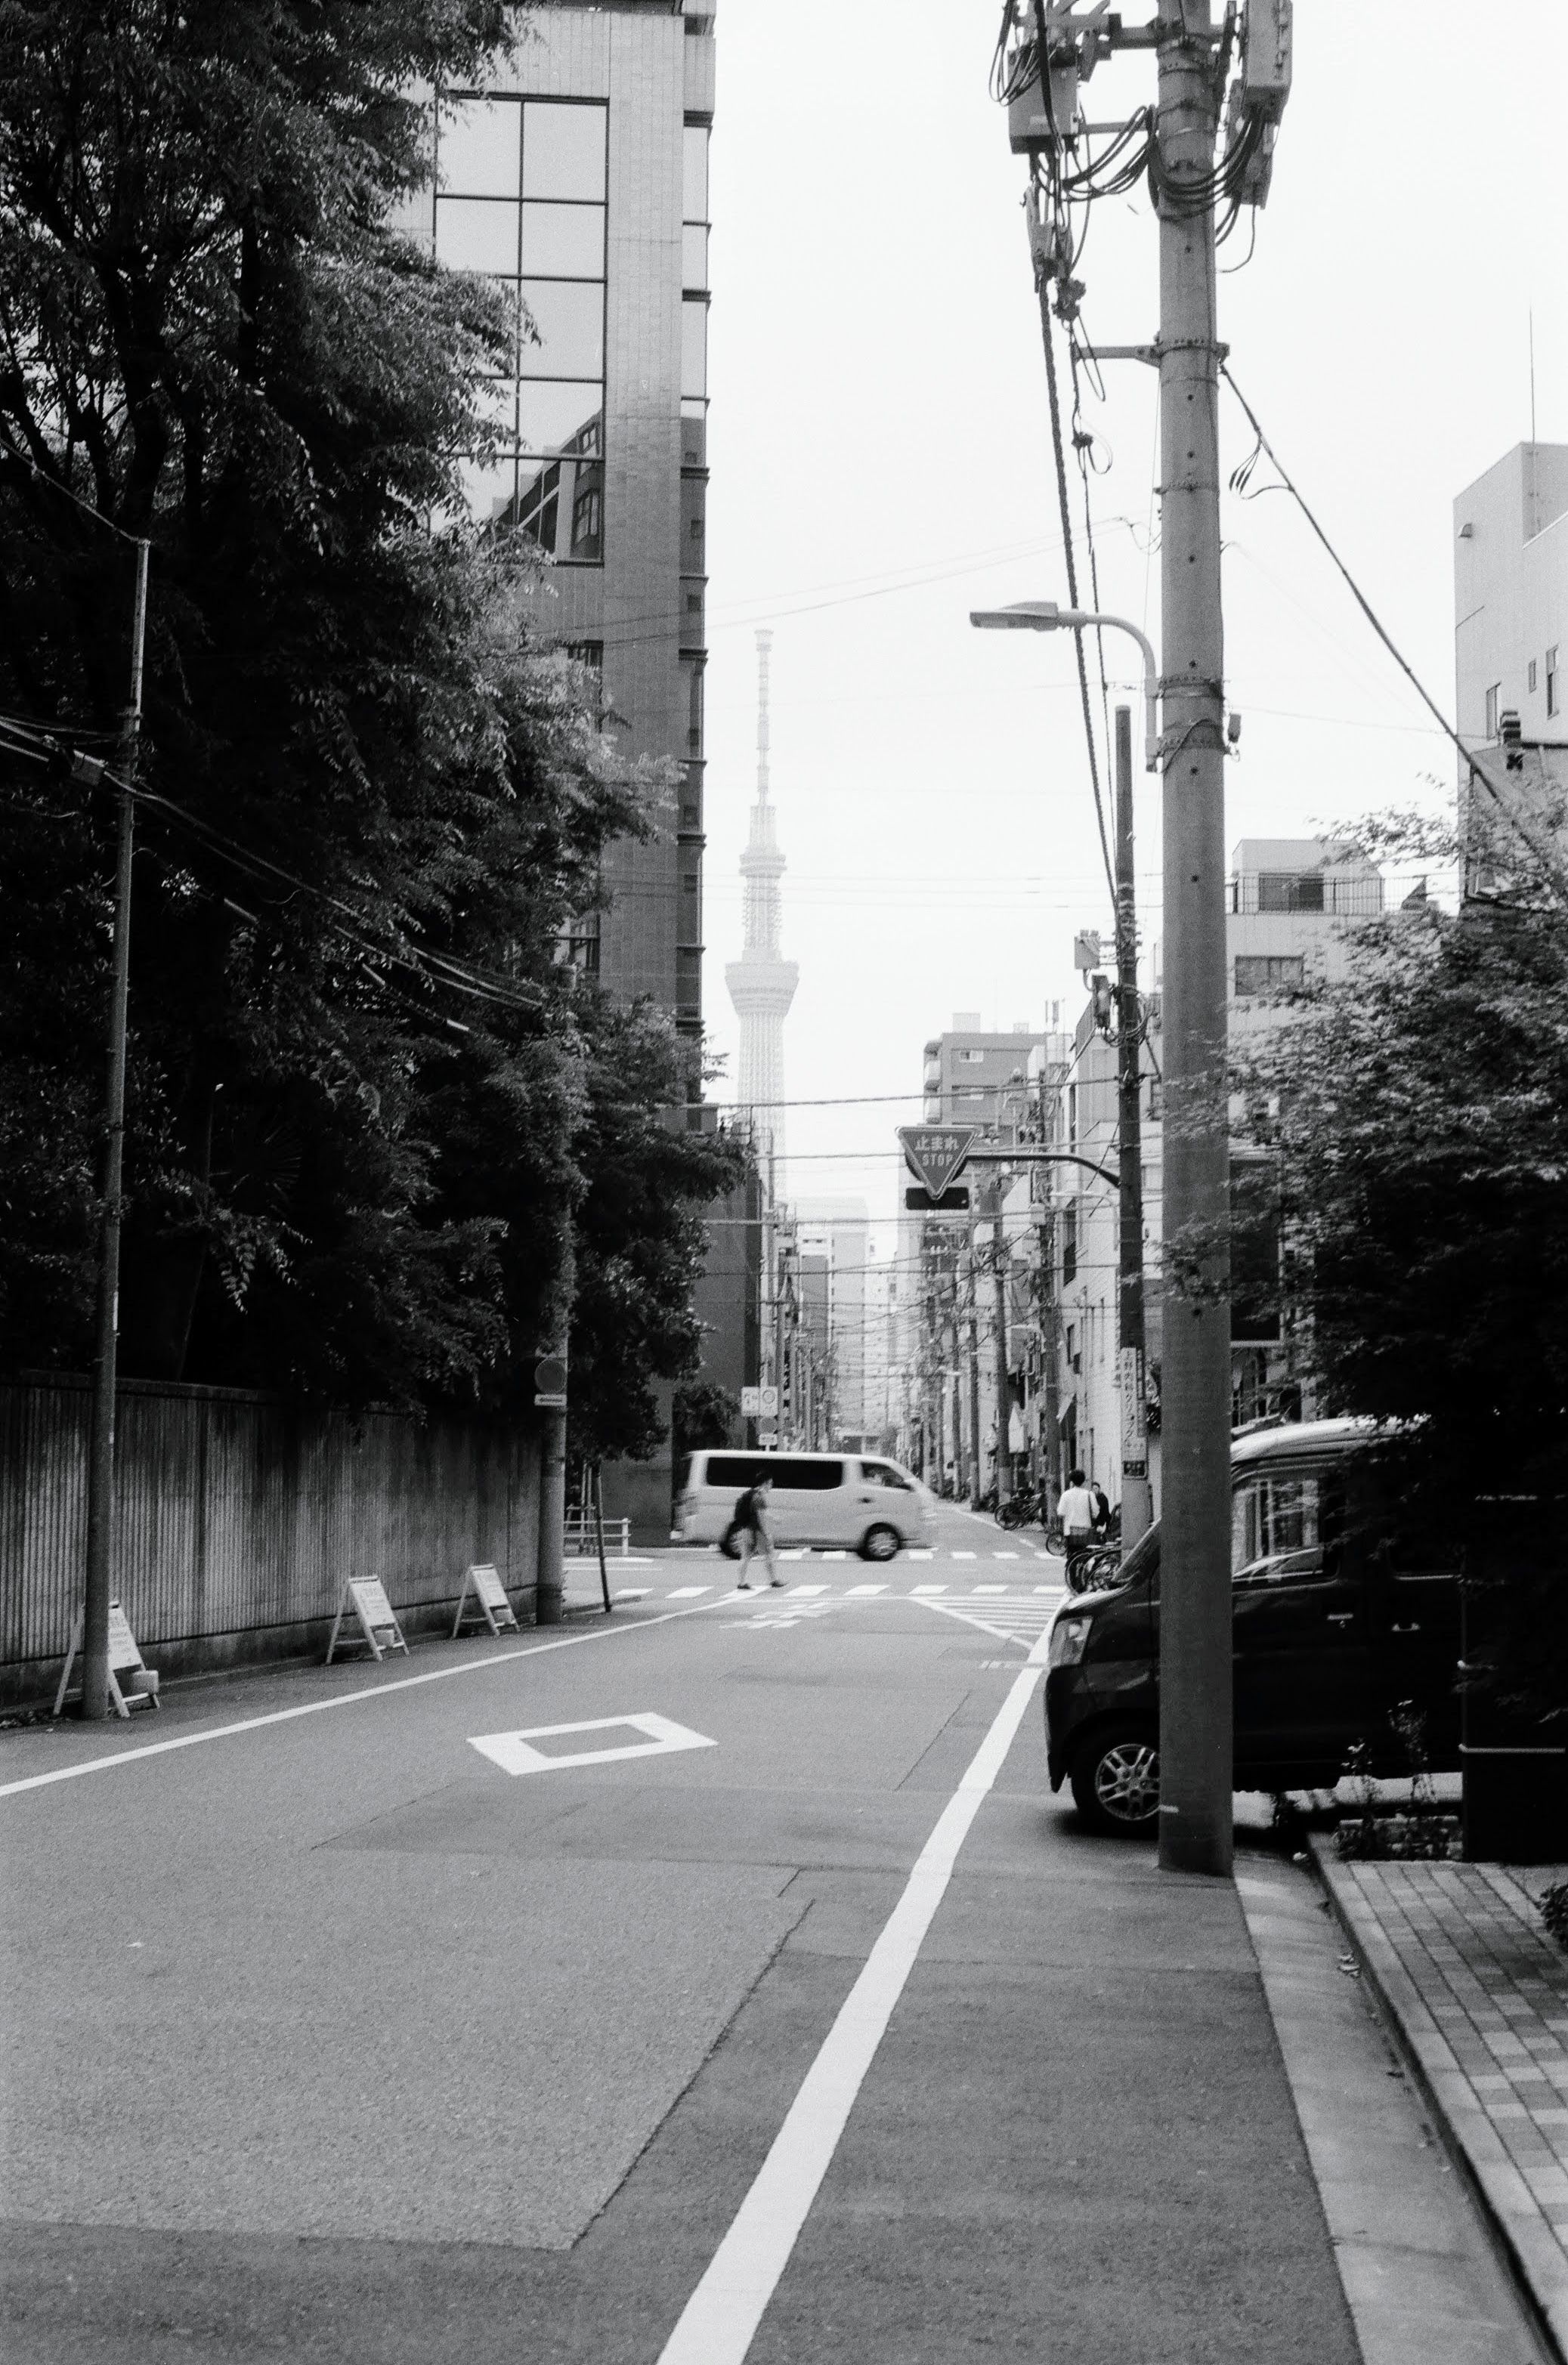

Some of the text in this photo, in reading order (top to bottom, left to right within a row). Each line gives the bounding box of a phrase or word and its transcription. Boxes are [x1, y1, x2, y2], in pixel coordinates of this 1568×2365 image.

[915, 1134, 959, 1152] 止まれ
[923, 1154, 953, 1167] STOP
